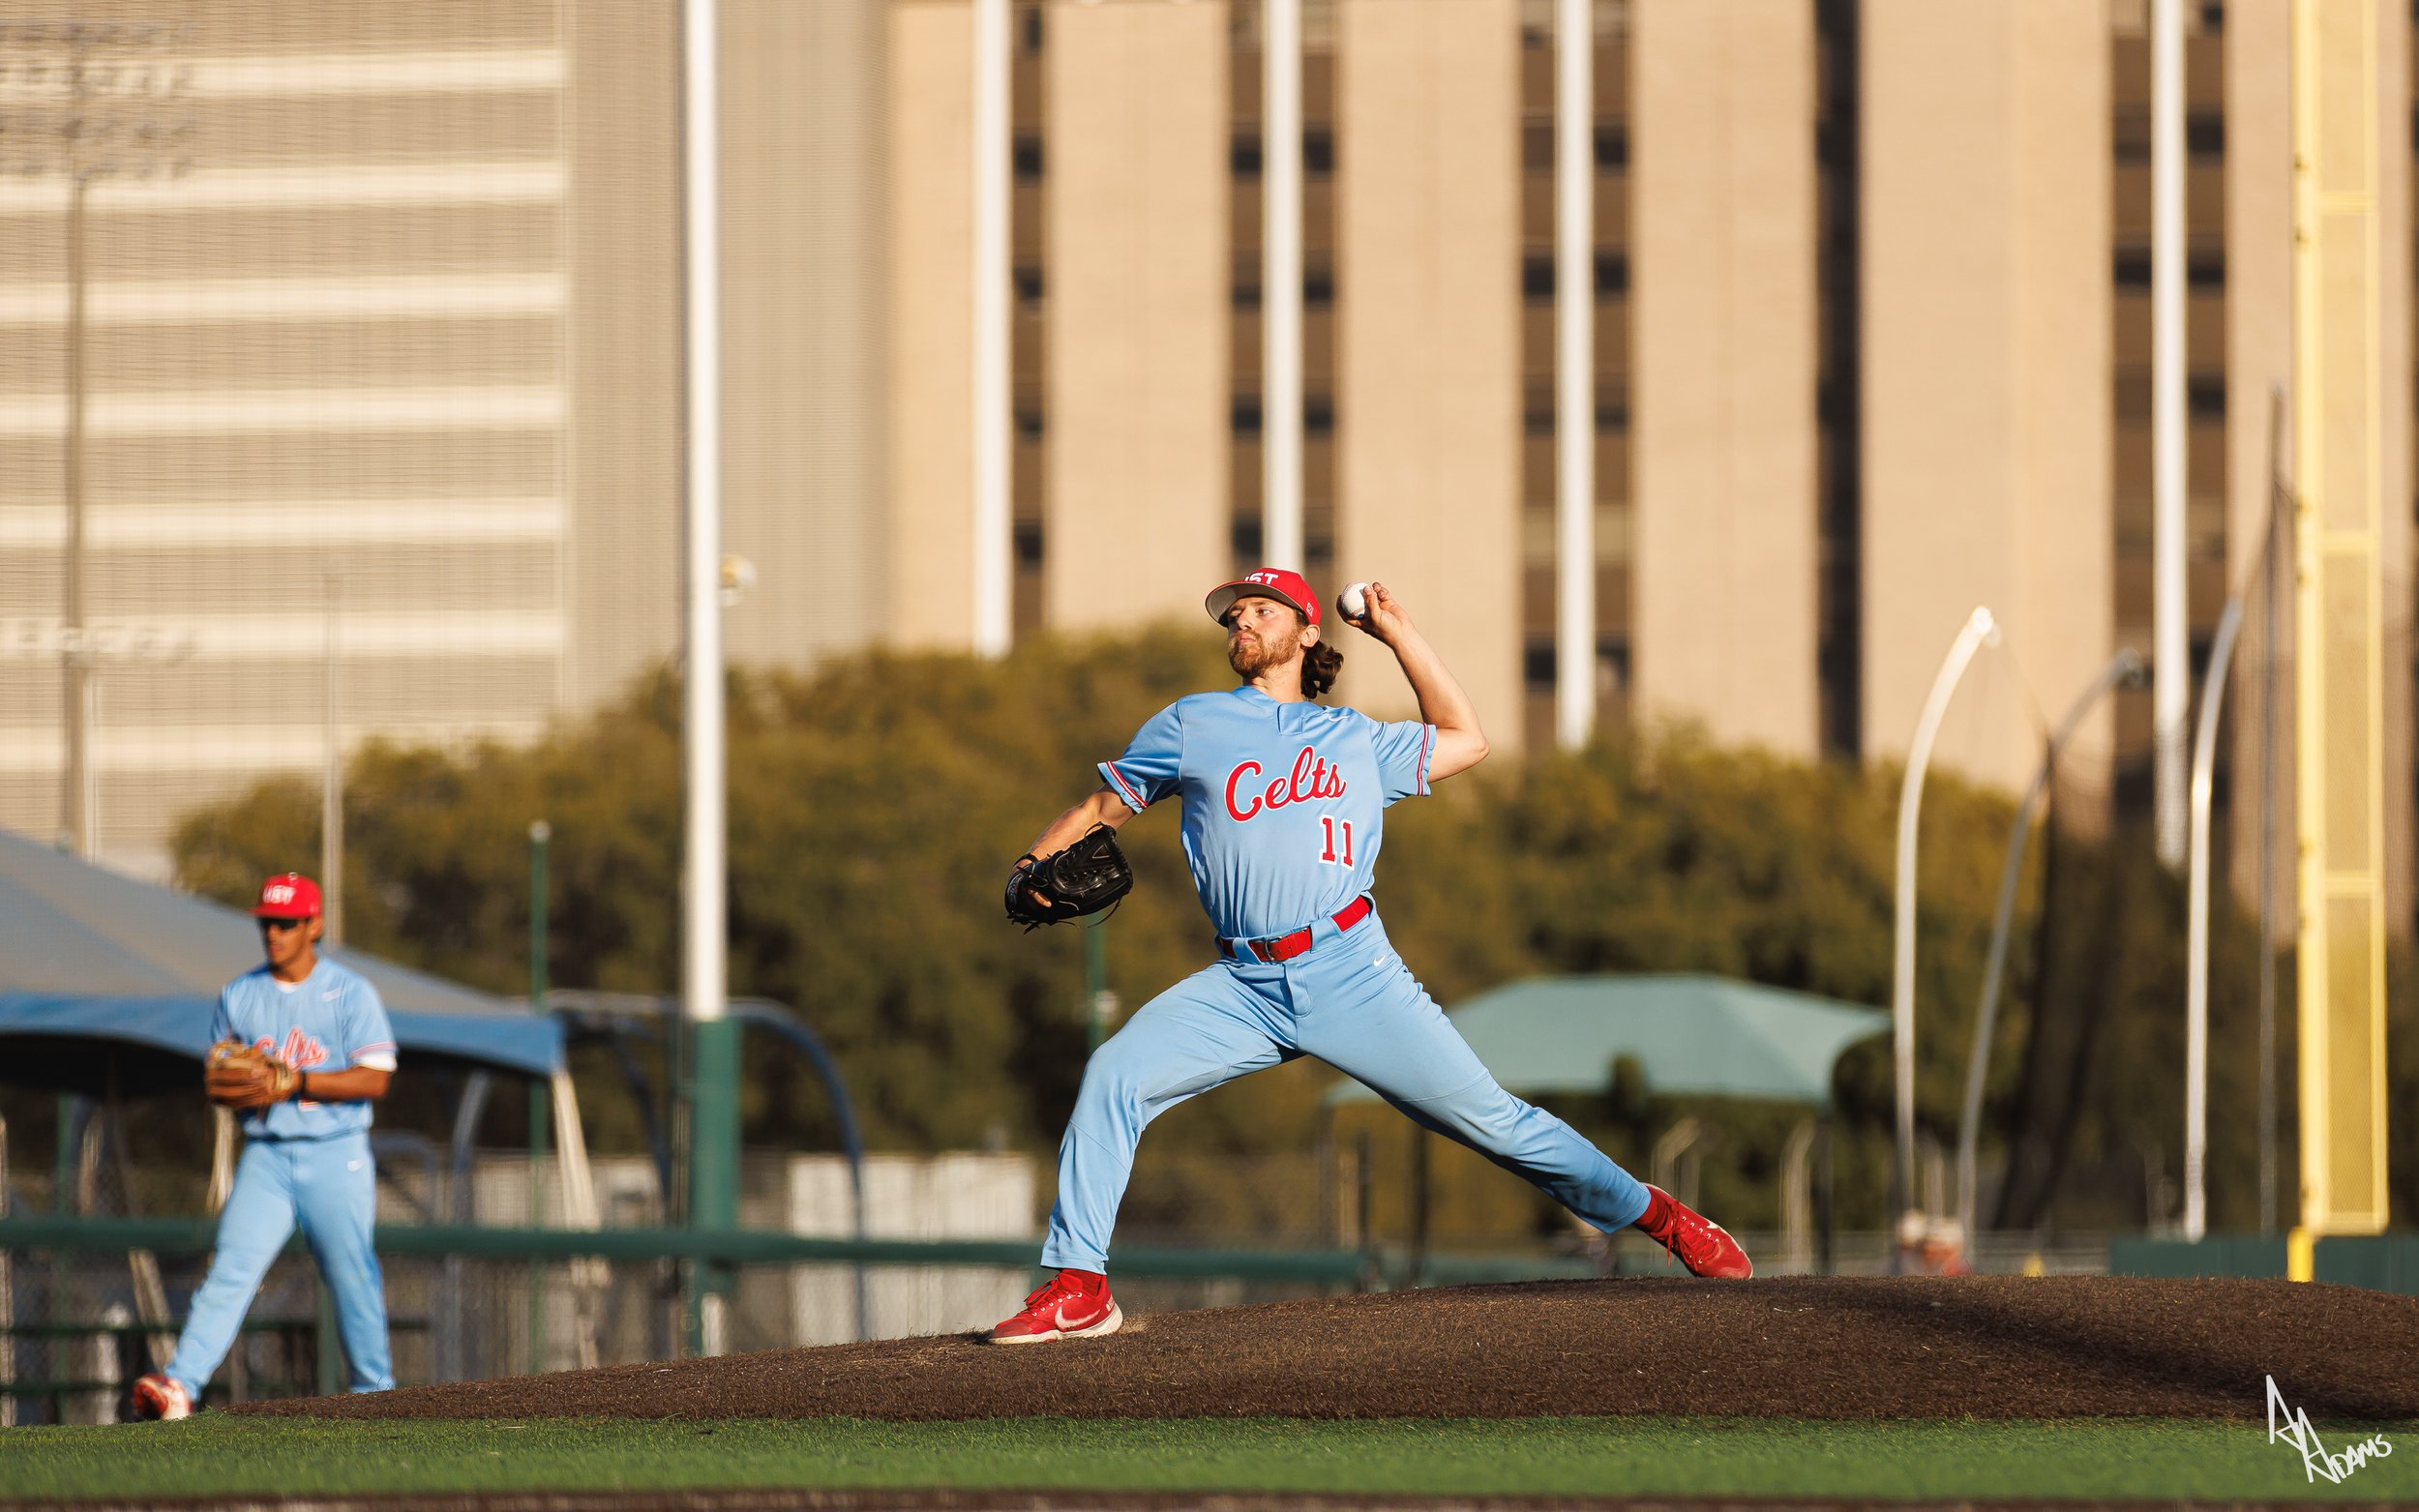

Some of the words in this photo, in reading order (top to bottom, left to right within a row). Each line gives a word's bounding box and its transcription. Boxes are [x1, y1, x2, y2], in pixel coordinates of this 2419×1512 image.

[1244, 572, 1279, 585] ST
[1224, 745, 1347, 823] Celts
[1319, 814, 1354, 871] 11
